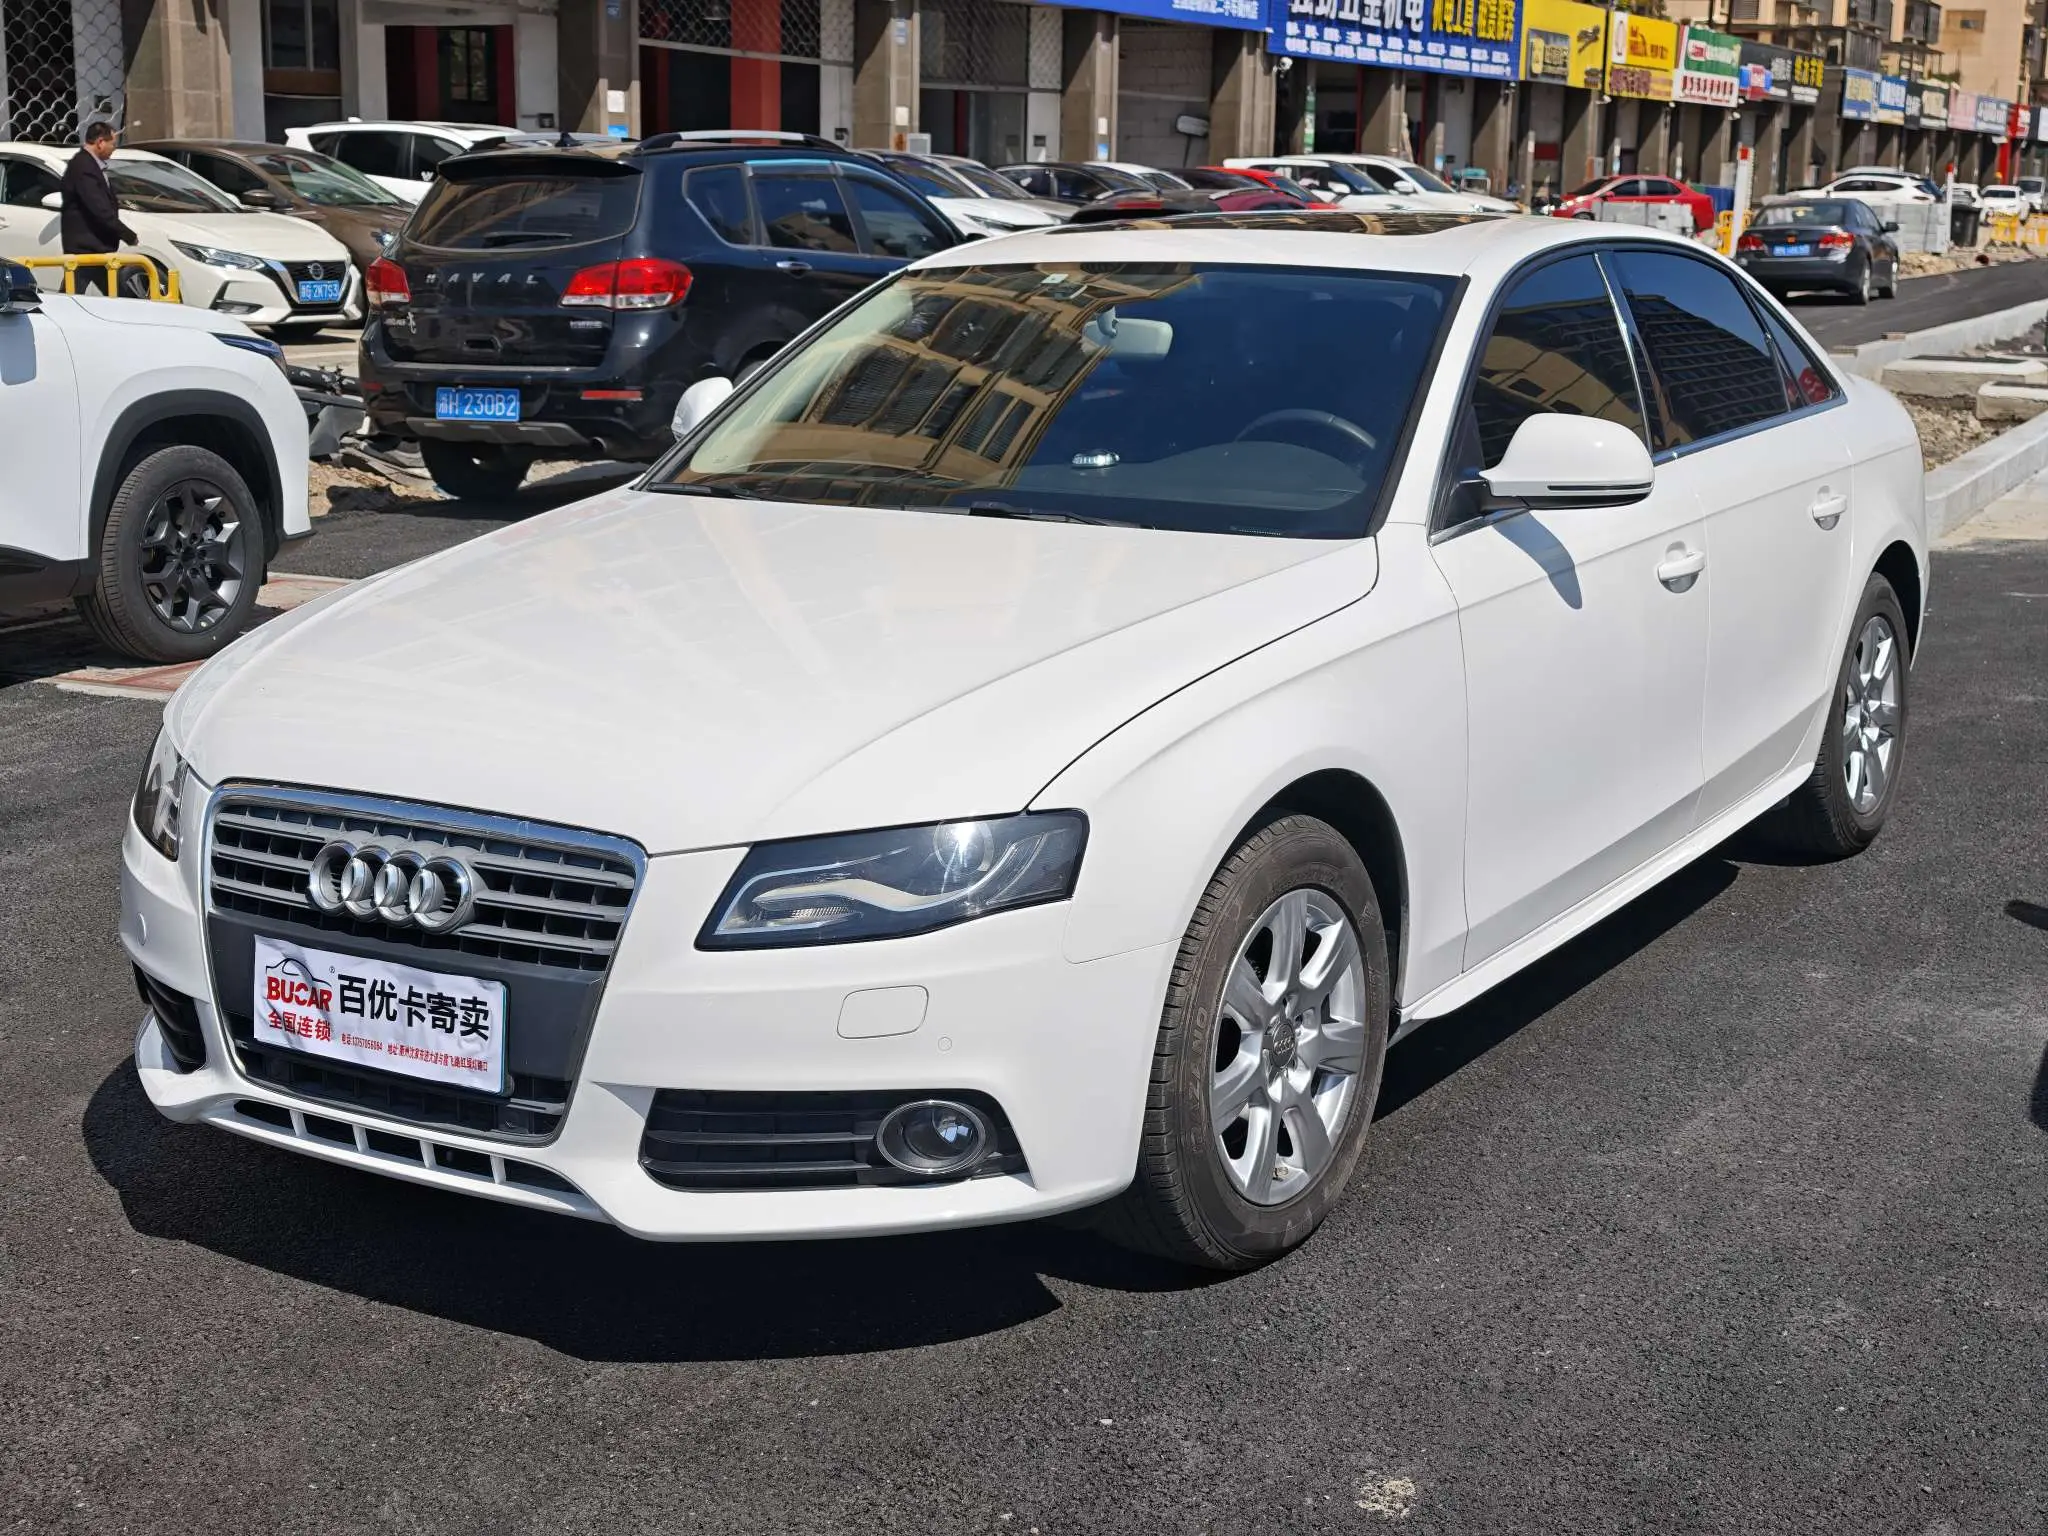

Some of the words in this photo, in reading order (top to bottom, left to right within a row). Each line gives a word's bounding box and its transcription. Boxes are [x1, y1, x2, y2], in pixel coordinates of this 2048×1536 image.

[426, 273, 538, 284] HAVAL
[267, 976, 332, 1012] BUCAR
[337, 974, 489, 1042] 百优卡寄卖
[268, 1008, 332, 1042] 全国连锁
